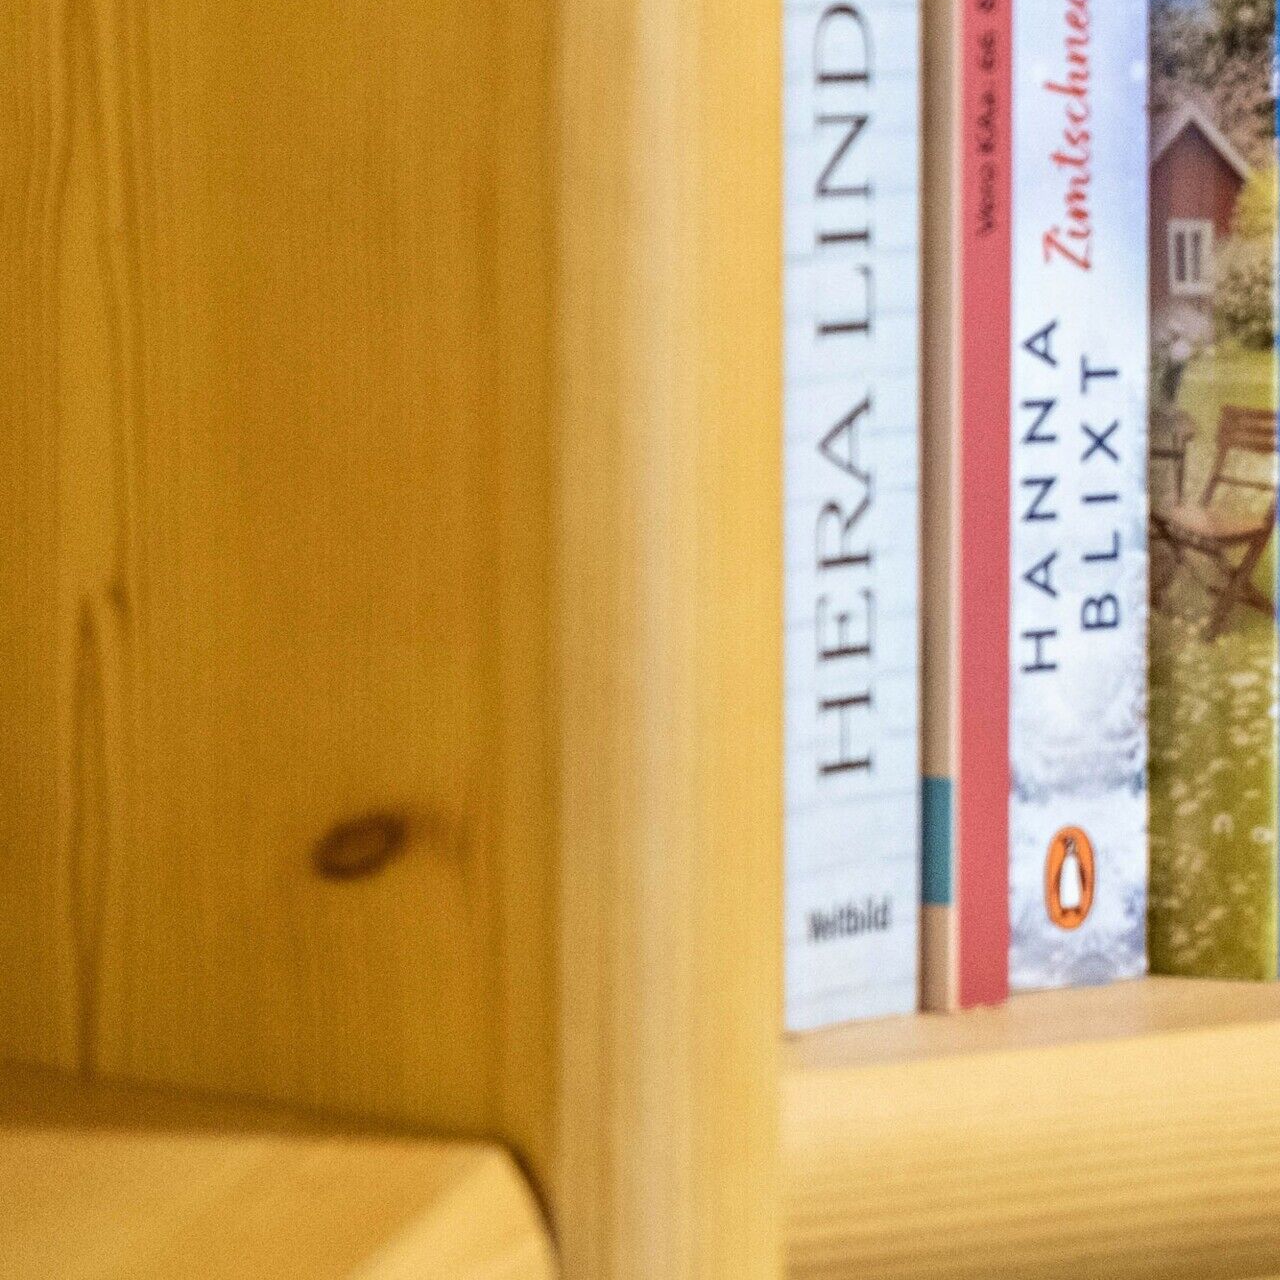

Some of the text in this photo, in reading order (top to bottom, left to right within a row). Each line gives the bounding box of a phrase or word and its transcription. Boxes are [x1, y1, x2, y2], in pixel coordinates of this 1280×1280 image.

[812, 1, 876, 778] HERA LIND
[1022, 319, 1060, 673] HANNA
[1080, 353, 1121, 632] BLIXT
